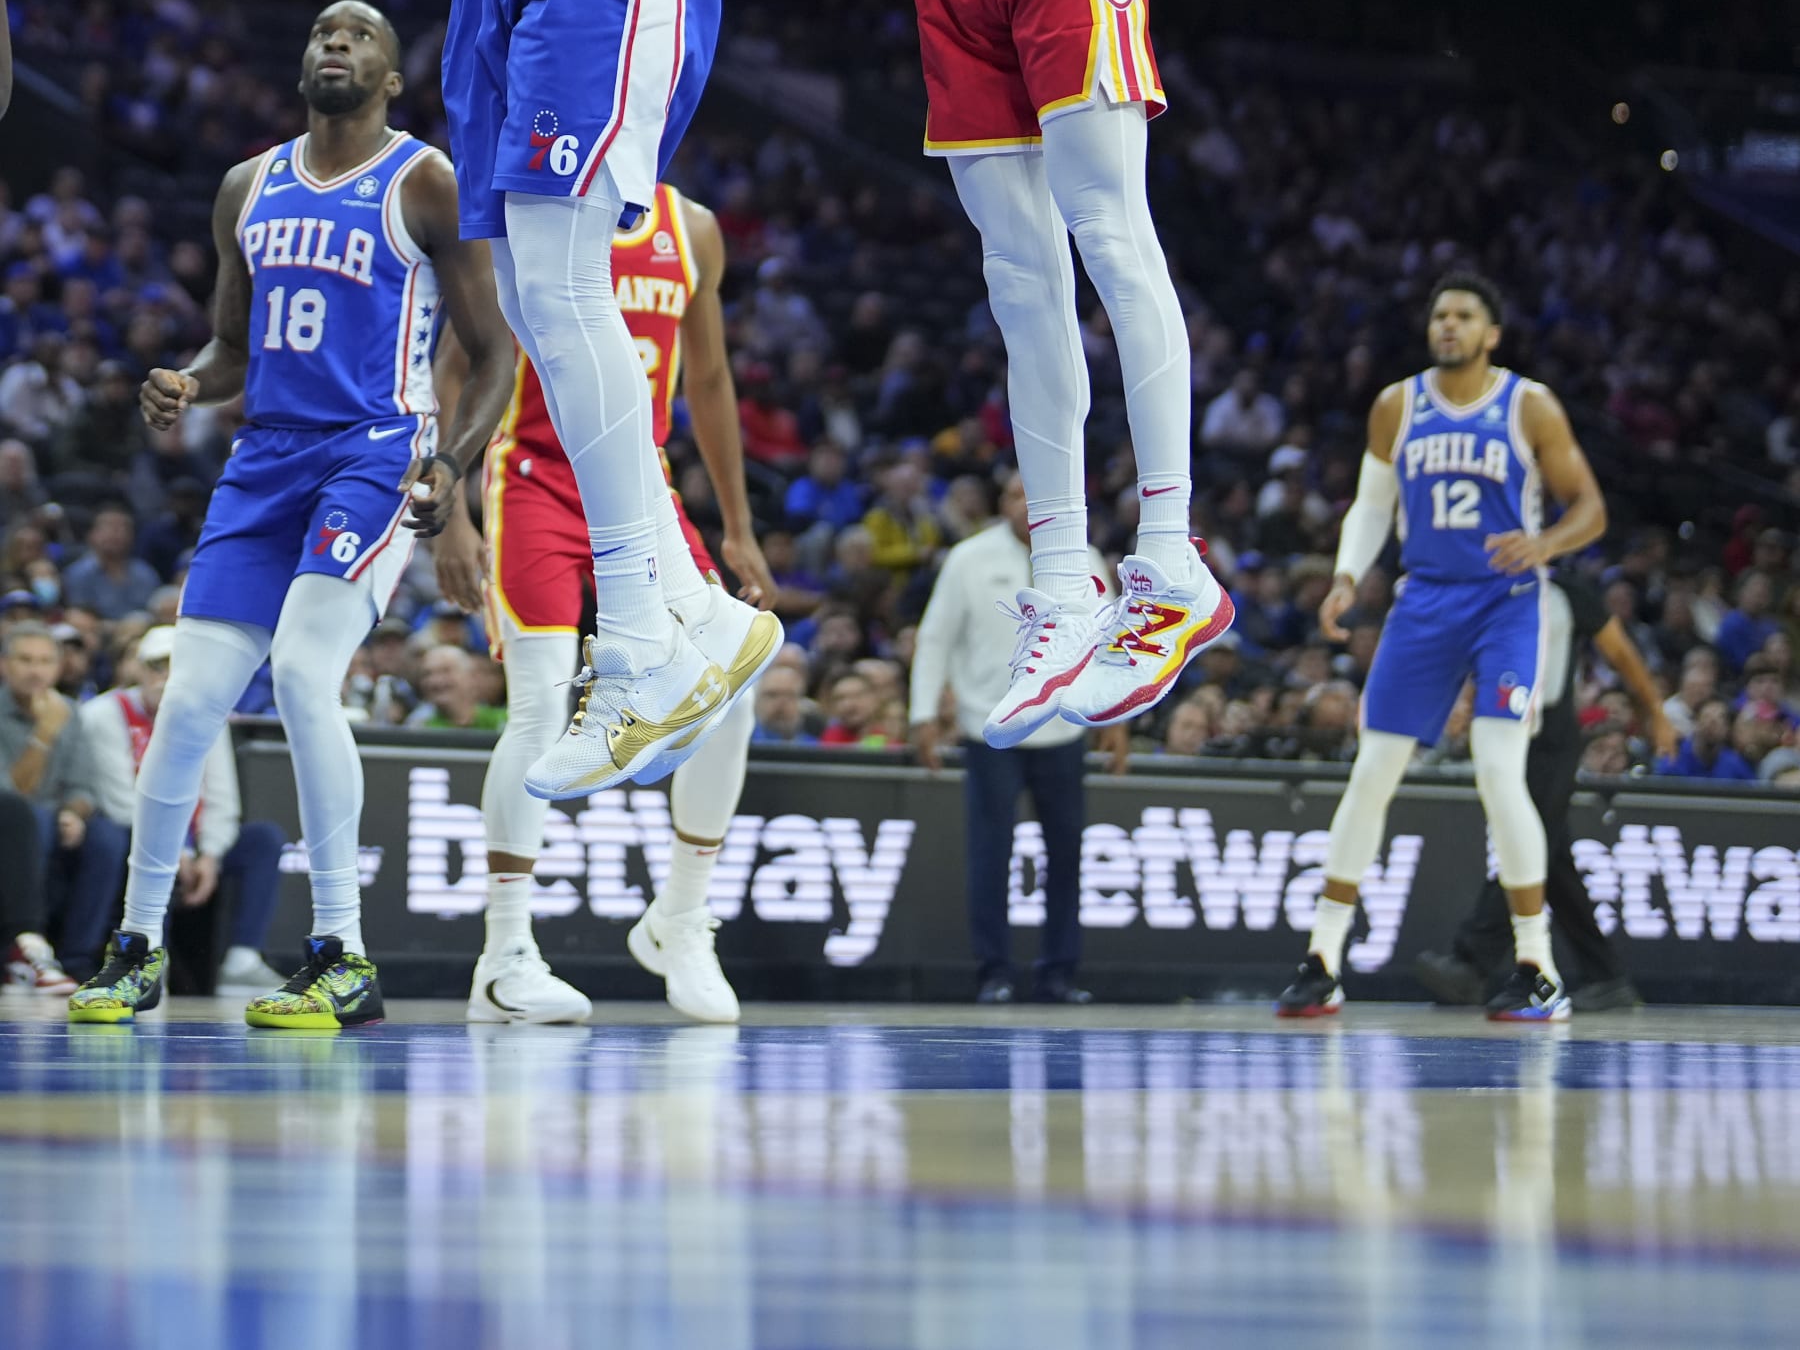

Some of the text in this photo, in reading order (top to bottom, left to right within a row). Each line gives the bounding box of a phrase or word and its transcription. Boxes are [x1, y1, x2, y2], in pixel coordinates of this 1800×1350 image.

[270, 157, 290, 176] 6
[528, 130, 580, 176] 76
[243, 217, 376, 286] PHILA
[263, 285, 328, 352] 18
[1404, 431, 1509, 484] PHILA
[1431, 479, 1481, 530] 12
[312, 527, 362, 563] 76
[407, 767, 917, 967] betway
[1570, 824, 1800, 943] etwa
